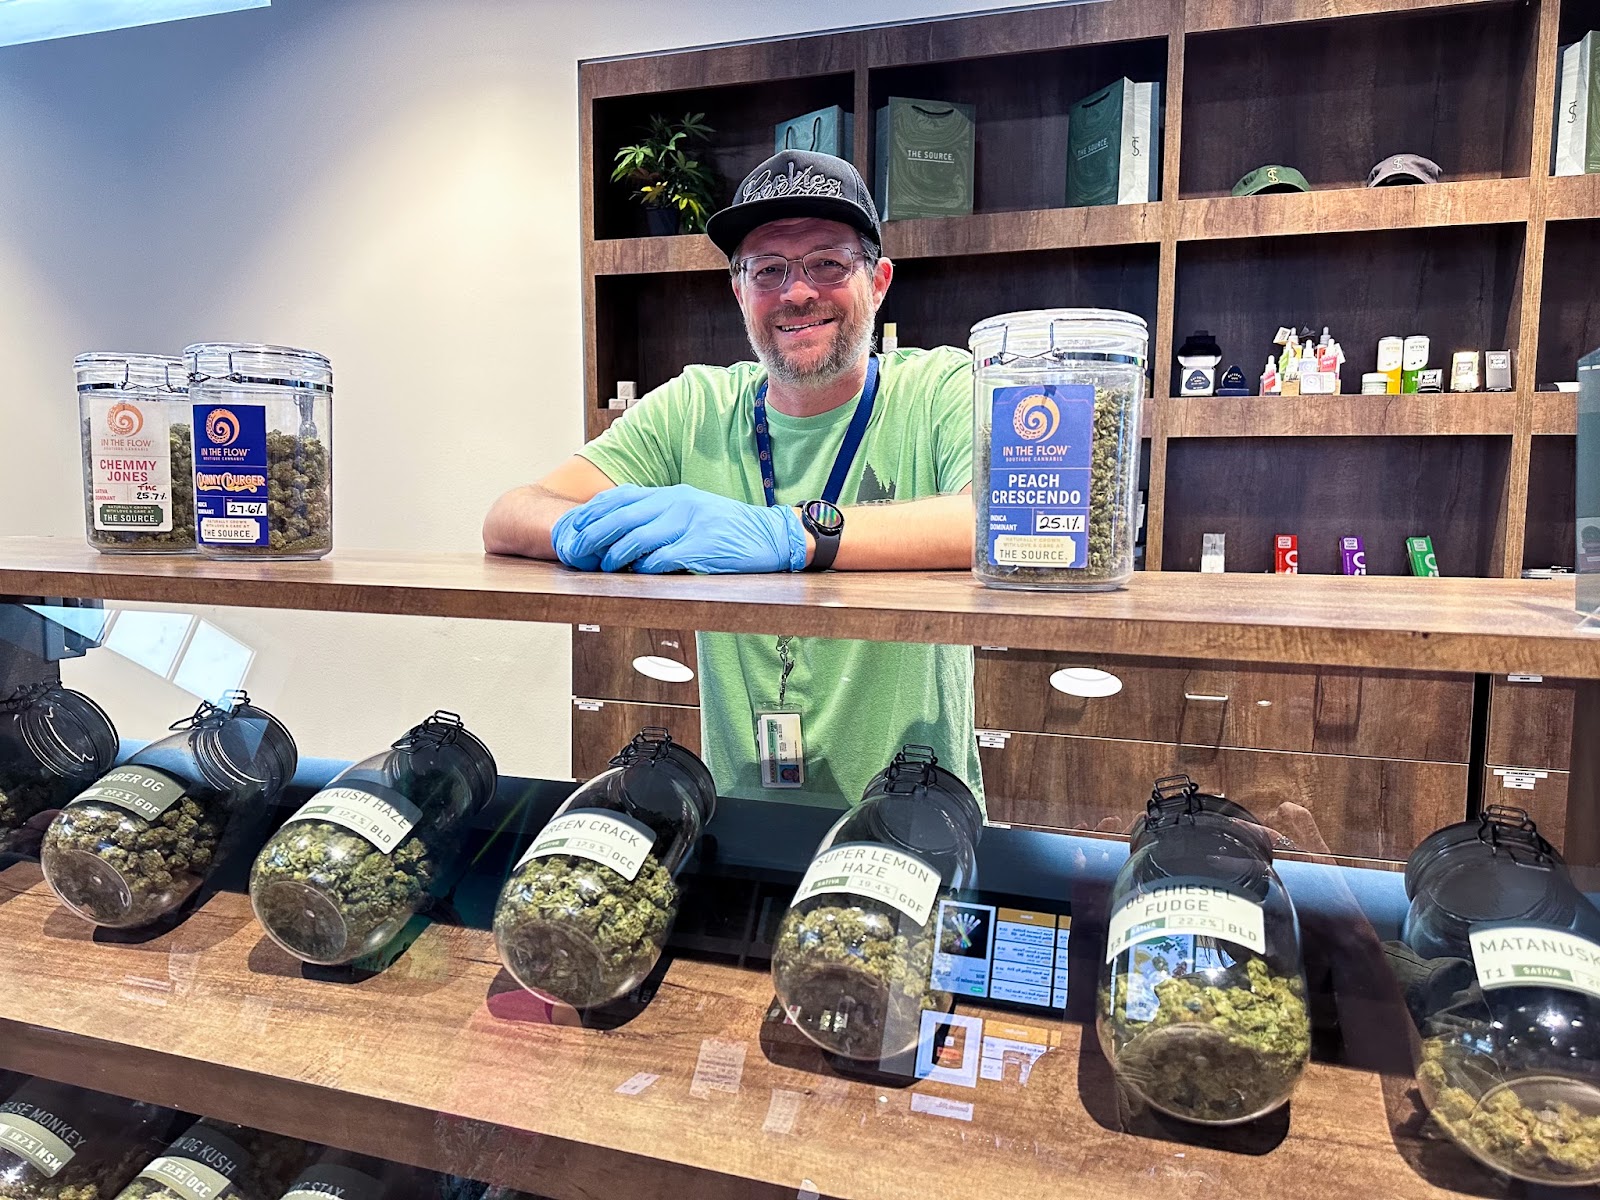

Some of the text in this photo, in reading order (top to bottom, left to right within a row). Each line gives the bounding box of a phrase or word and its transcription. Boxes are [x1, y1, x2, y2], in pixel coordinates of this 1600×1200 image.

[907, 150, 955, 161] THE SOURCE.
[1077, 148, 1087, 156] THE
[111, 439, 124, 447] THE
[1003, 446, 1068, 456] IN THE FLOW
[201, 448, 247, 457] IN THE FLOW
[100, 459, 156, 470] CHEMMY
[107, 471, 148, 482] JONES
[222, 472, 265, 493] BURGER
[1008, 474, 1060, 488] PEACH
[992, 490, 1081, 505] CRESCENDO
[218, 530, 254, 538] SOURCE.
[1000, 549, 1068, 560] THE SOURCE.
[141, 777, 164, 792] OG
[134, 798, 160, 814] GDF
[331, 789, 372, 804] KUSH
[372, 801, 410, 829] HAZE
[370, 824, 392, 844] BLD
[589, 820, 639, 847] CRACK
[611, 851, 635, 870] OCC
[815, 848, 929, 883] SUPER LEMON
[841, 863, 888, 879] HAZE
[1152, 883, 1236, 902] CHIESEL
[899, 893, 924, 914] GDF
[1145, 899, 1209, 917] FUDGE
[1228, 923, 1257, 942] BLD
[1522, 966, 1560, 977] SATIVA
[29, 1107, 87, 1149] MONKEY
[35, 1147, 63, 1171] NSM
[182, 1138, 203, 1152] OG
[197, 1144, 237, 1176] KUSH
[186, 1176, 212, 1198] OCC
